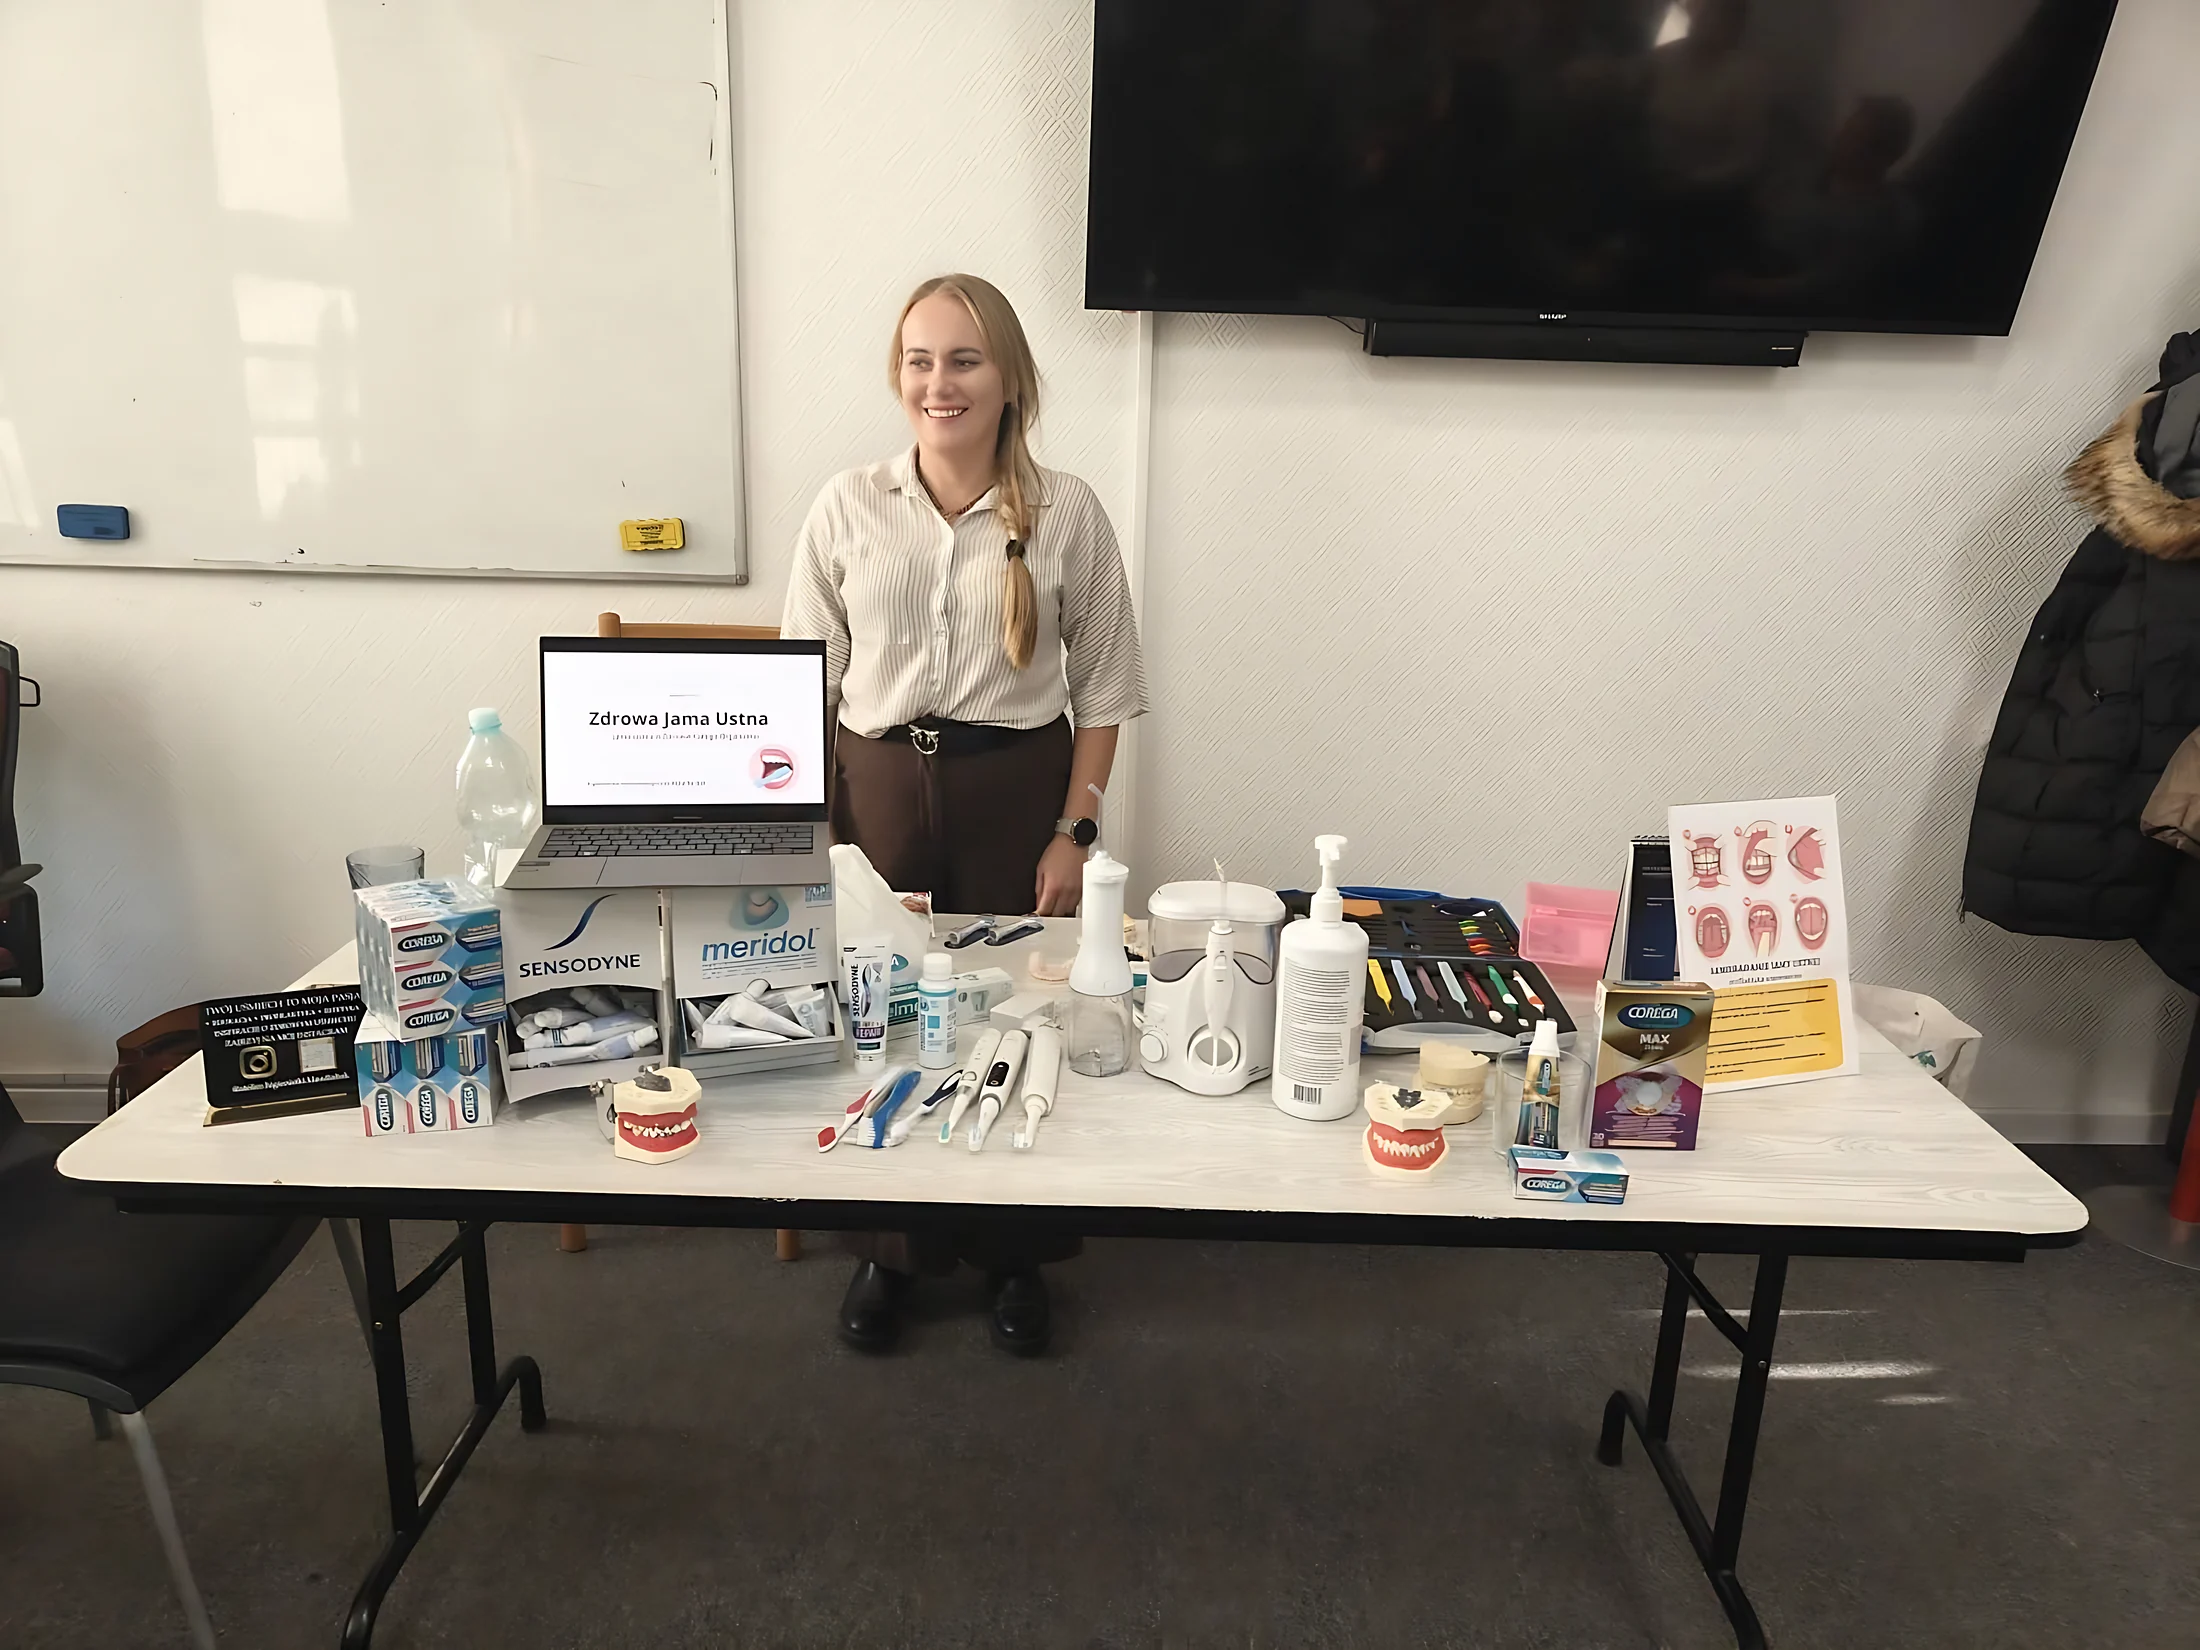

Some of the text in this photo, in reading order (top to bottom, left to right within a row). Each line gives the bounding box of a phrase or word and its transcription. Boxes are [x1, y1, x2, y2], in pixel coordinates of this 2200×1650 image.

[589, 711, 768, 729] Zdrowa Jama Ustna
[702, 927, 816, 961] meridol
[519, 954, 641, 978] SENSODYNE
[851, 964, 860, 1017] SENSODYNE
[1628, 1007, 1678, 1019] COREGA
[1639, 1034, 1670, 1044] MAX
[1526, 1179, 1566, 1190] COREGA
